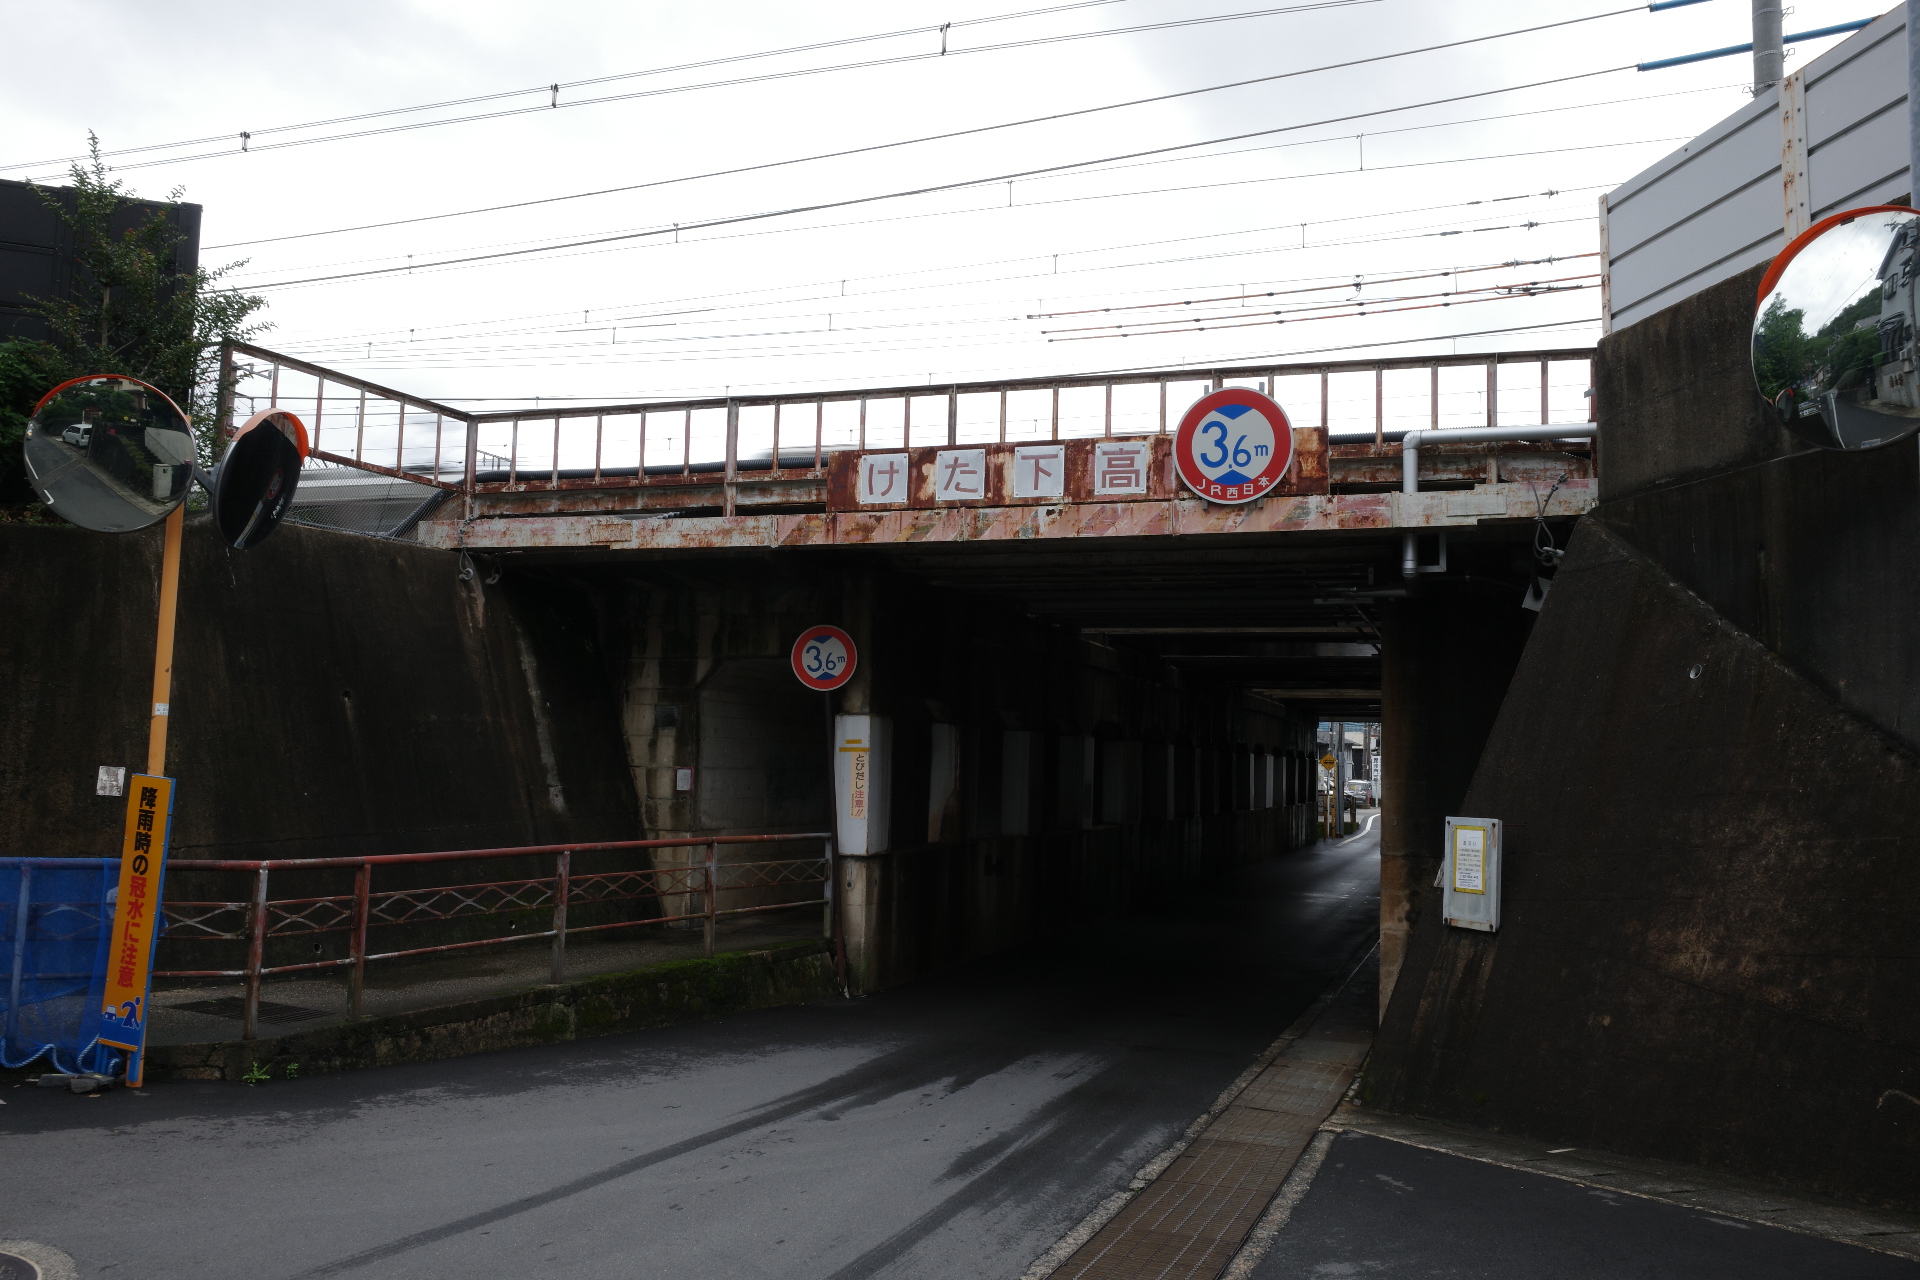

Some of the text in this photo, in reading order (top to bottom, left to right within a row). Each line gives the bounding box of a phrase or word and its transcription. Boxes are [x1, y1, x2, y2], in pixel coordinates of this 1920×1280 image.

[868, 448, 1141, 497] けた下高
[1196, 476, 1270, 499] JR西日本
[117, 786, 158, 989] 降雨時の冠水に注意
